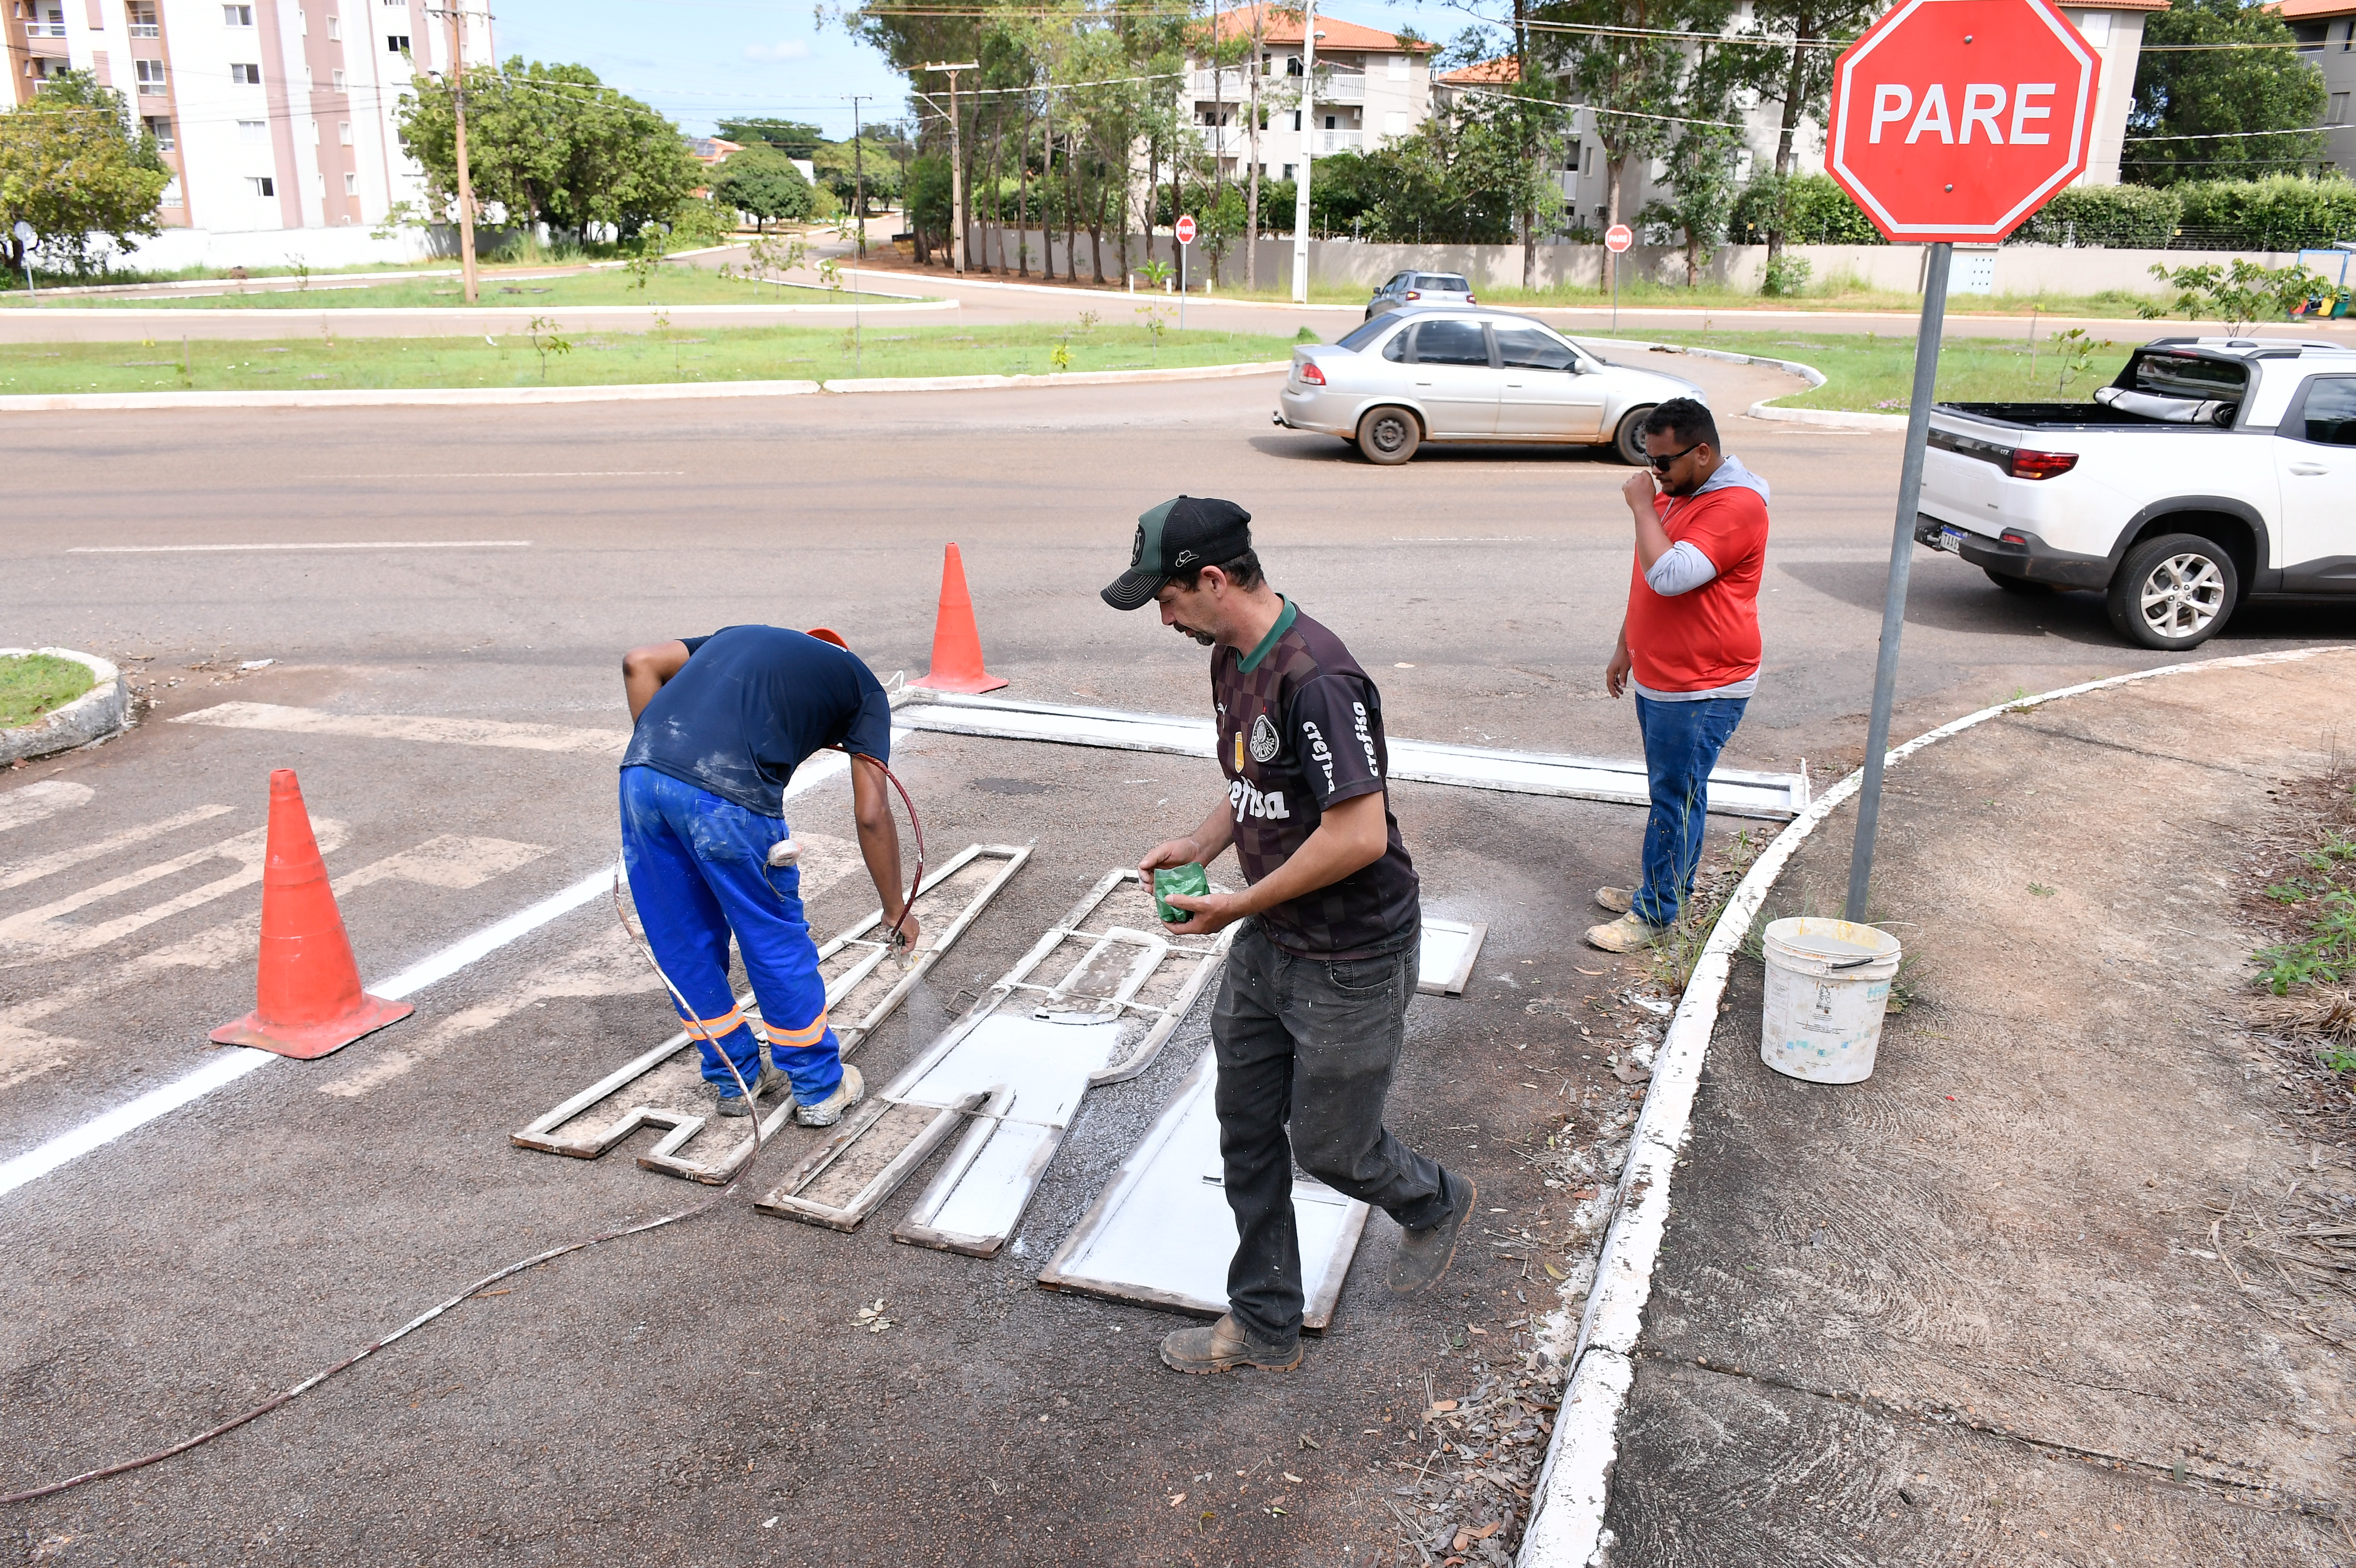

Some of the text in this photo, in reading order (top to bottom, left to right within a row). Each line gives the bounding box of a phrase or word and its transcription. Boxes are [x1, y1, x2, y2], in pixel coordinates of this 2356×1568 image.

[1869, 83, 2056, 145] PARE
[1178, 226, 1194, 234] PARE
[1609, 234, 1628, 243] PARE
[1353, 701, 1379, 777] crefisa
[1228, 775, 1290, 823] efisa
